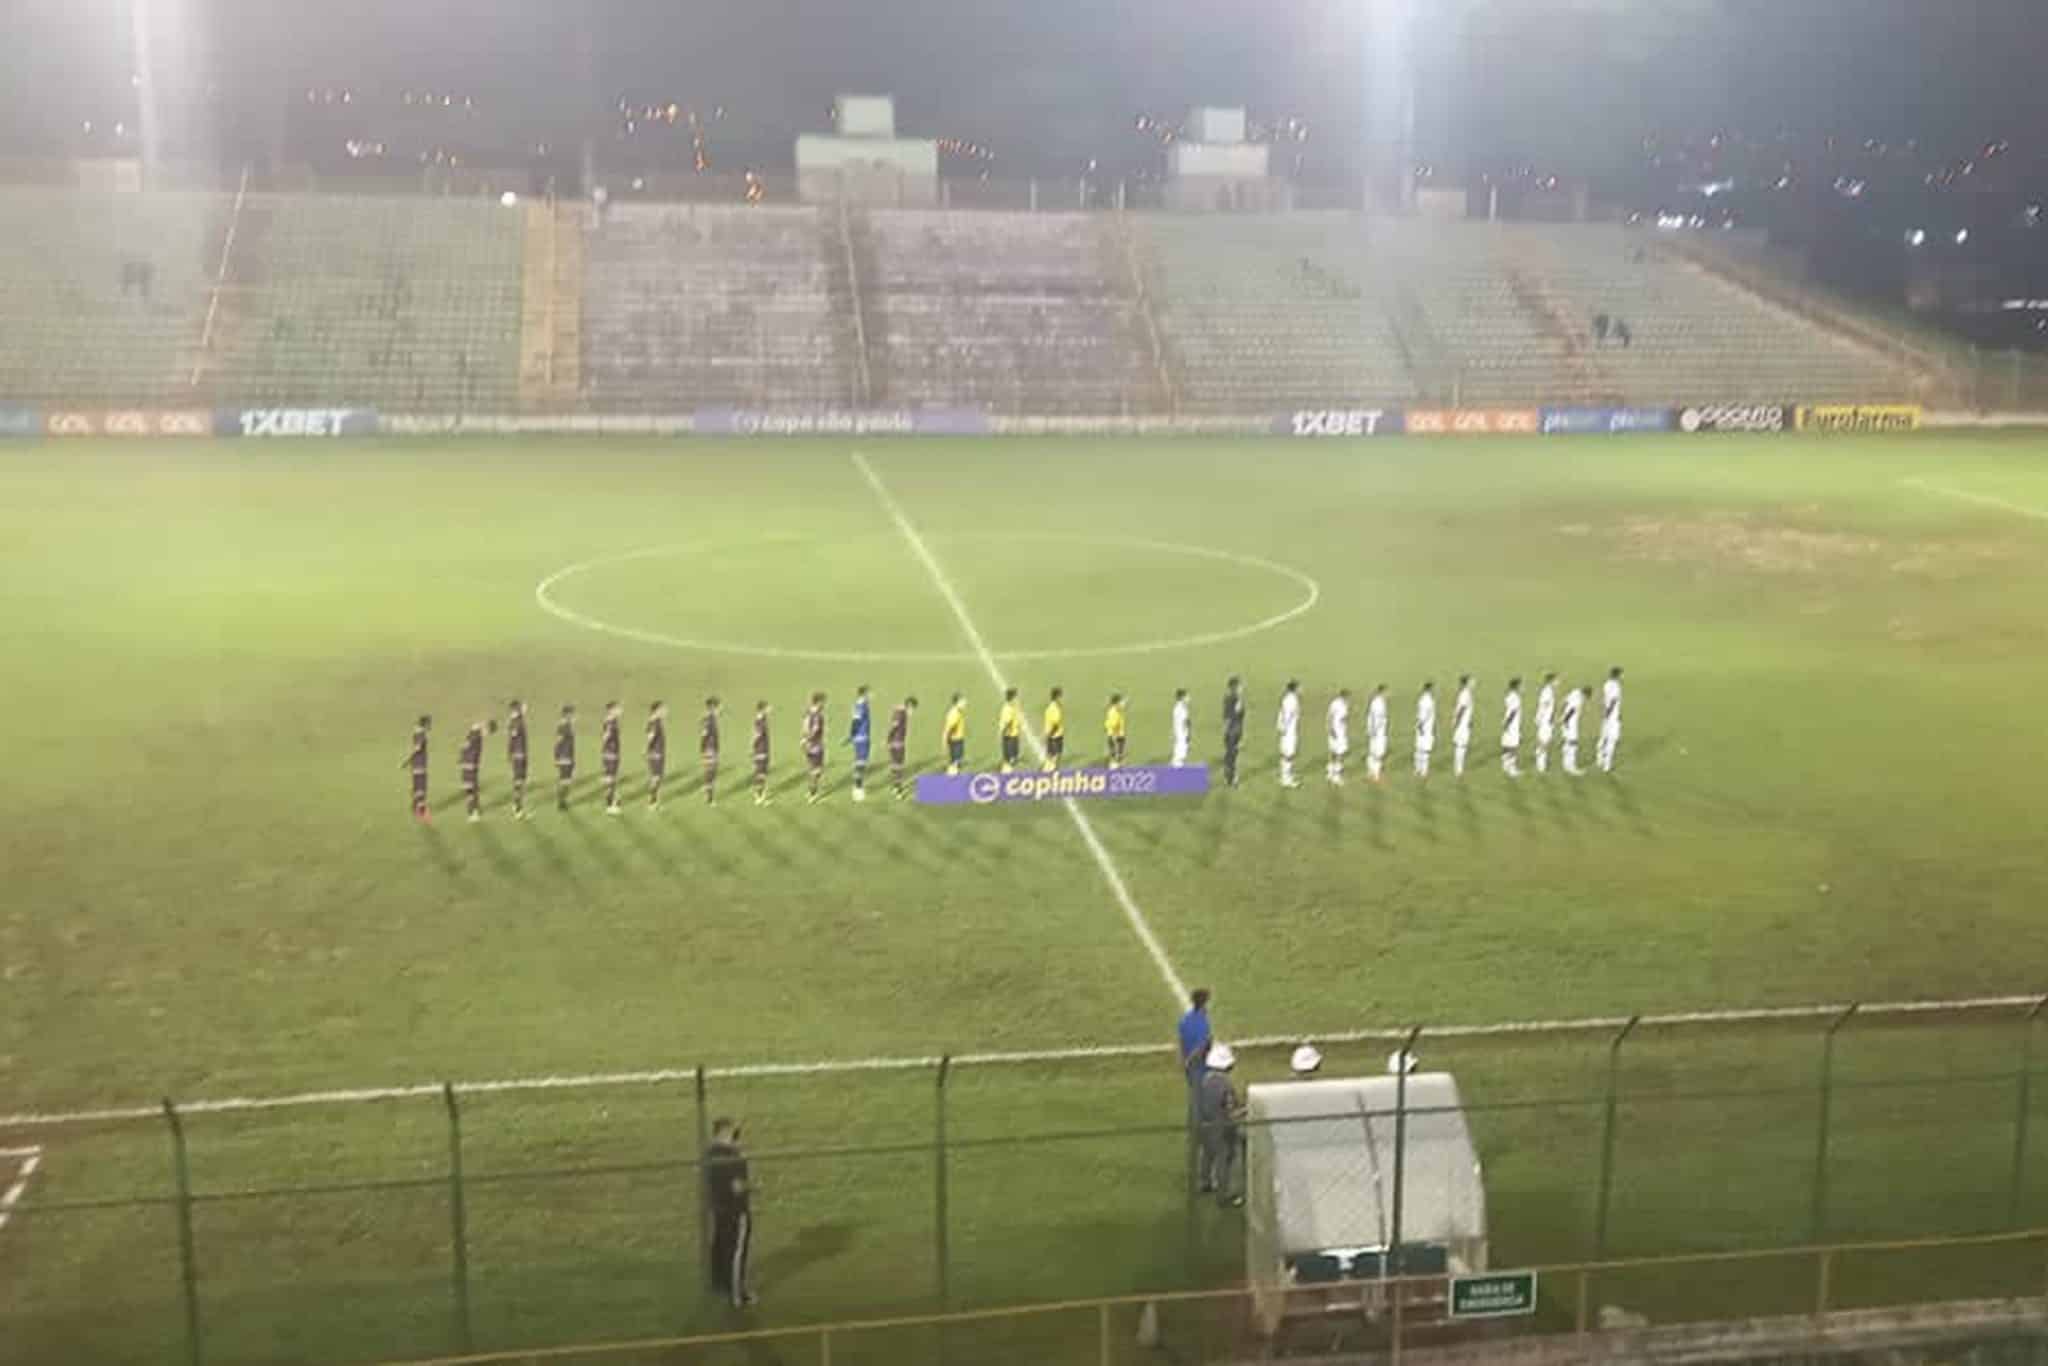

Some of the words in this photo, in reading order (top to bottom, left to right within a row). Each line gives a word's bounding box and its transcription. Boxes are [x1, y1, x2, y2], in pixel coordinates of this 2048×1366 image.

[239, 409, 352, 436] 1XBET
[1291, 410, 1383, 435] 1XBET
[1005, 772, 1106, 799] copinha
[1110, 772, 1155, 792] 2022
